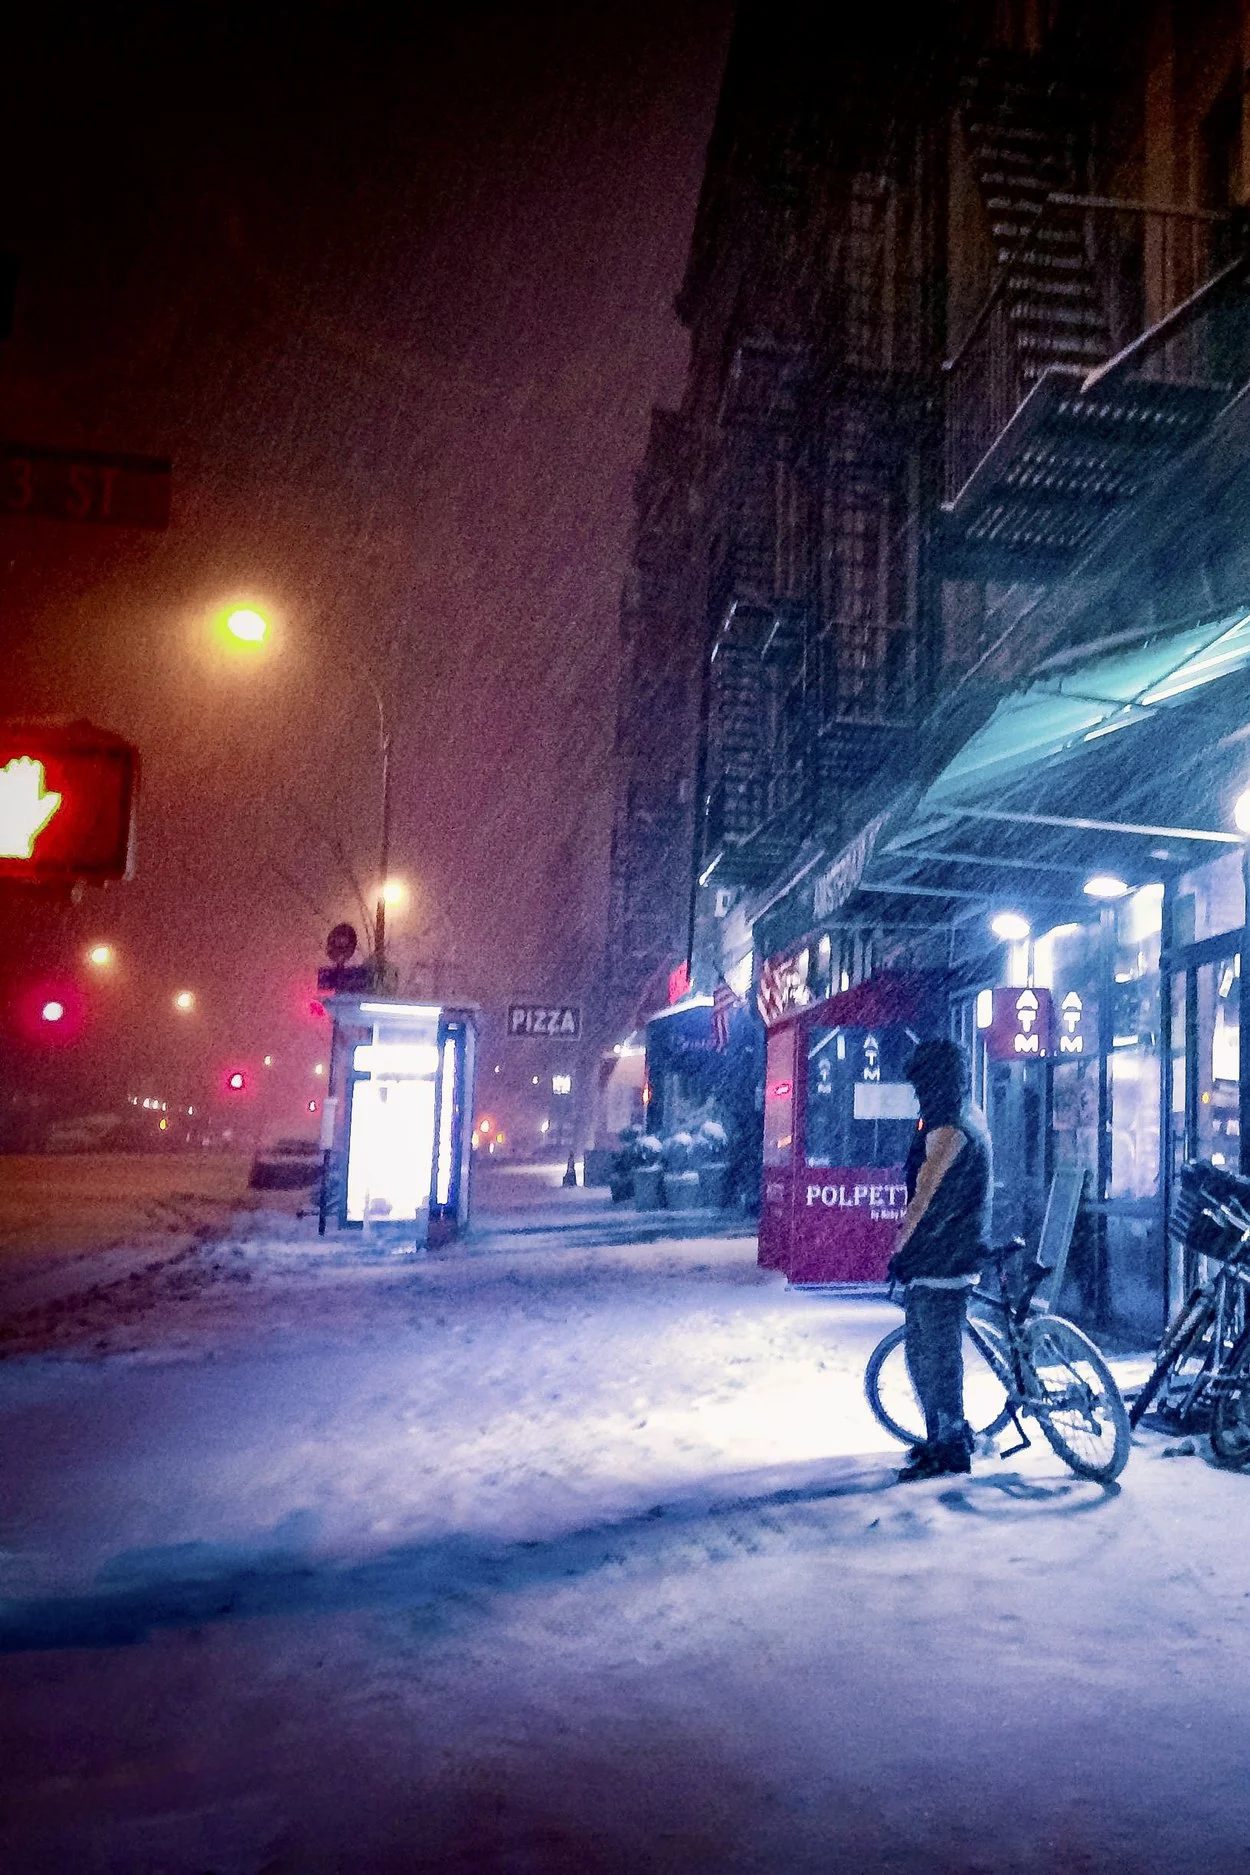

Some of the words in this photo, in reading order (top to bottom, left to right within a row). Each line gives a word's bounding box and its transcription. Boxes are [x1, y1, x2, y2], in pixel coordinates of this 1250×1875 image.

[65, 464, 121, 518] ST
[512, 1008, 576, 1035] PIZZA
[1014, 989, 1039, 1053] ATM
[1060, 991, 1083, 1053] ATM
[863, 1033, 881, 1081] ATM
